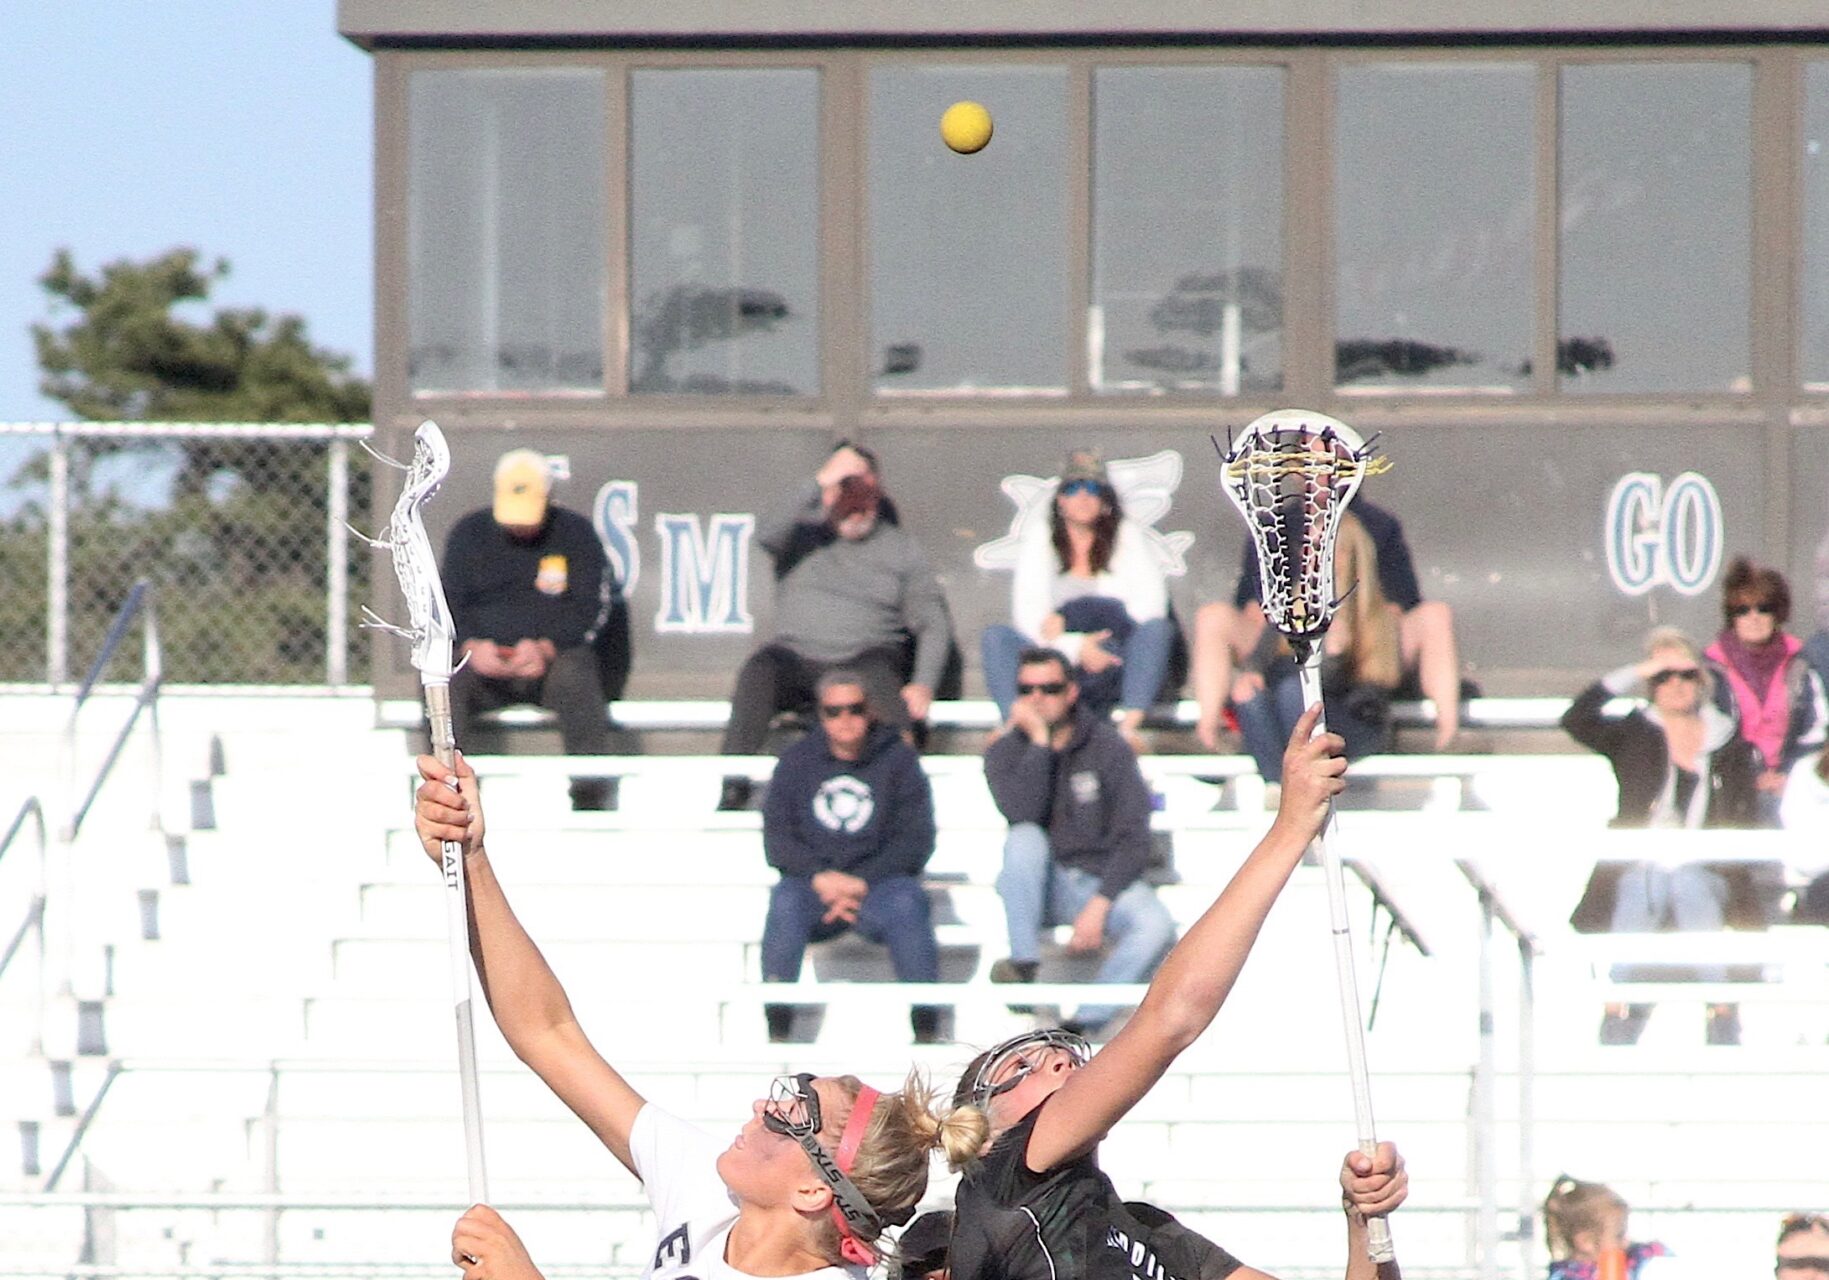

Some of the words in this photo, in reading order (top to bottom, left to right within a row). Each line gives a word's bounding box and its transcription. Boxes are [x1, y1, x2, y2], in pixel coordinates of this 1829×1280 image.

[1606, 471, 1724, 595] GO
[444, 840, 459, 891] GAIT
[811, 1147, 844, 1183] STX
